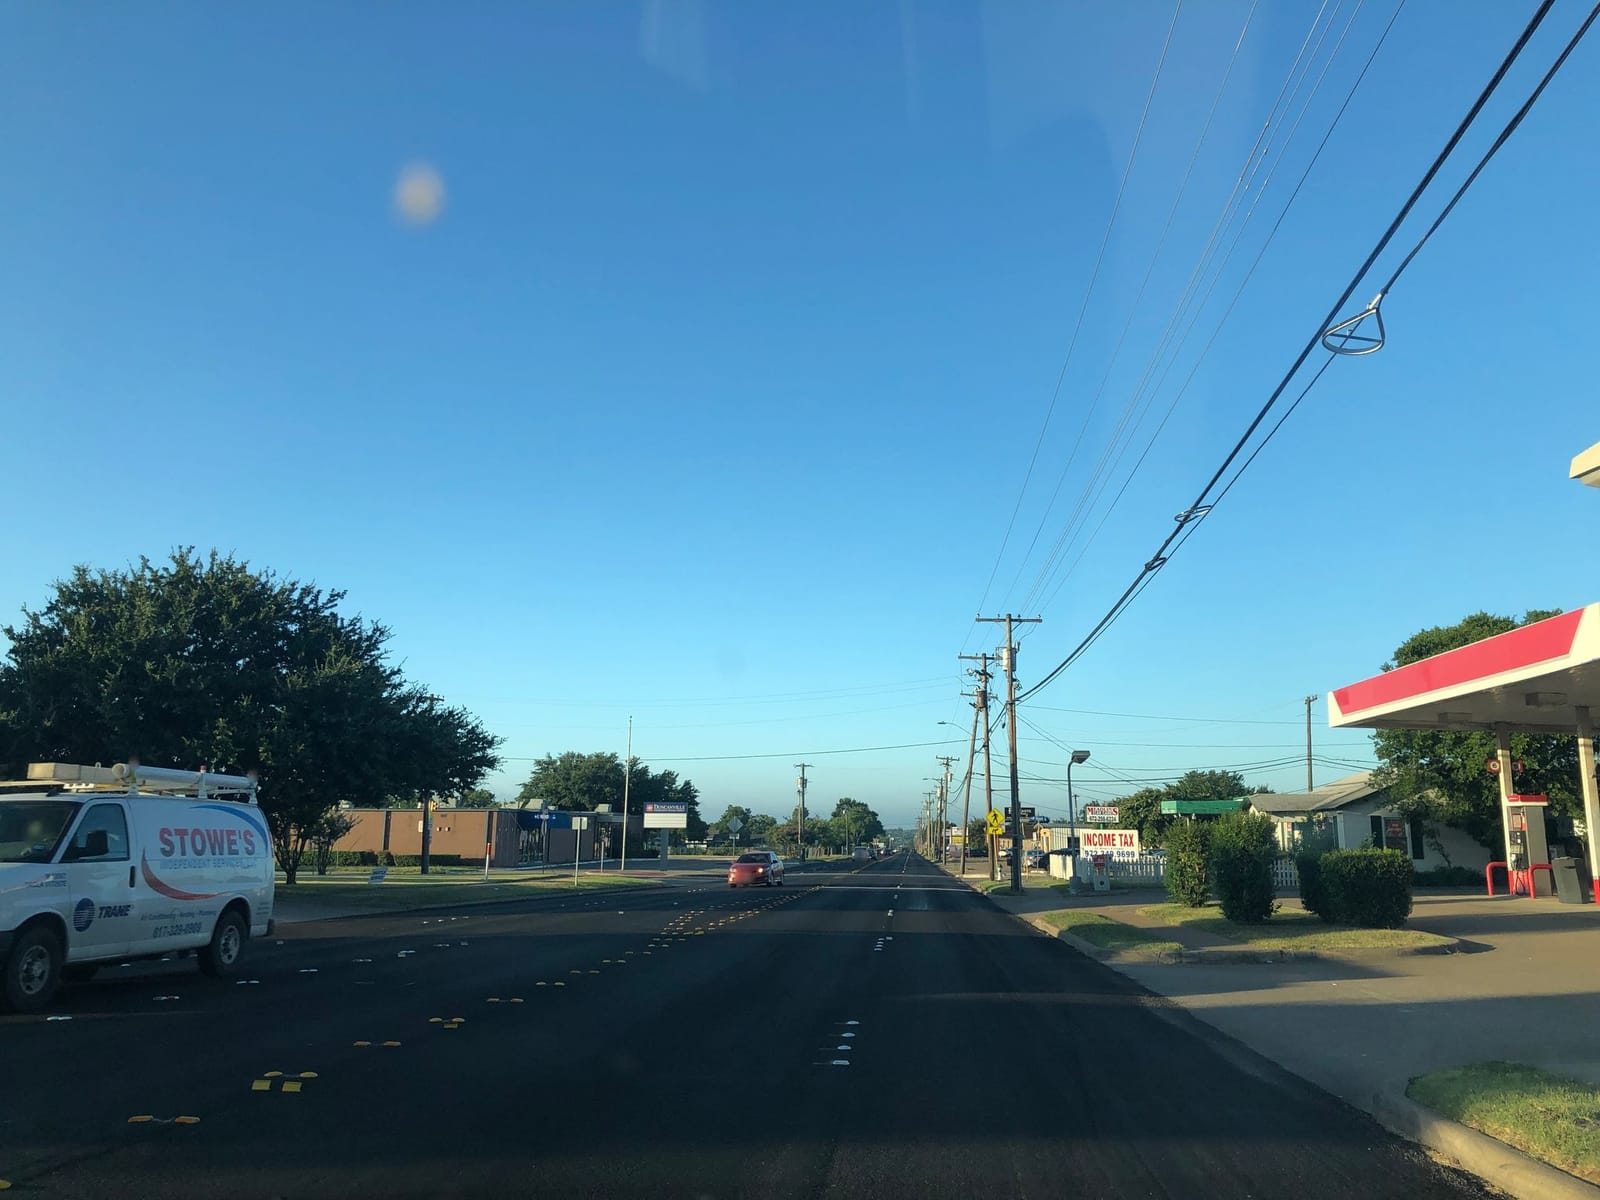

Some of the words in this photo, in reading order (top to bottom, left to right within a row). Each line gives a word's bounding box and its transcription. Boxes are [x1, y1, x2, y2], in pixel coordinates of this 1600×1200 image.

[159, 827, 256, 857] STOWE'S
[1084, 833, 1116, 847] INCOME
[1118, 833, 1134, 847] TAX
[98, 904, 131, 919] TRANE
